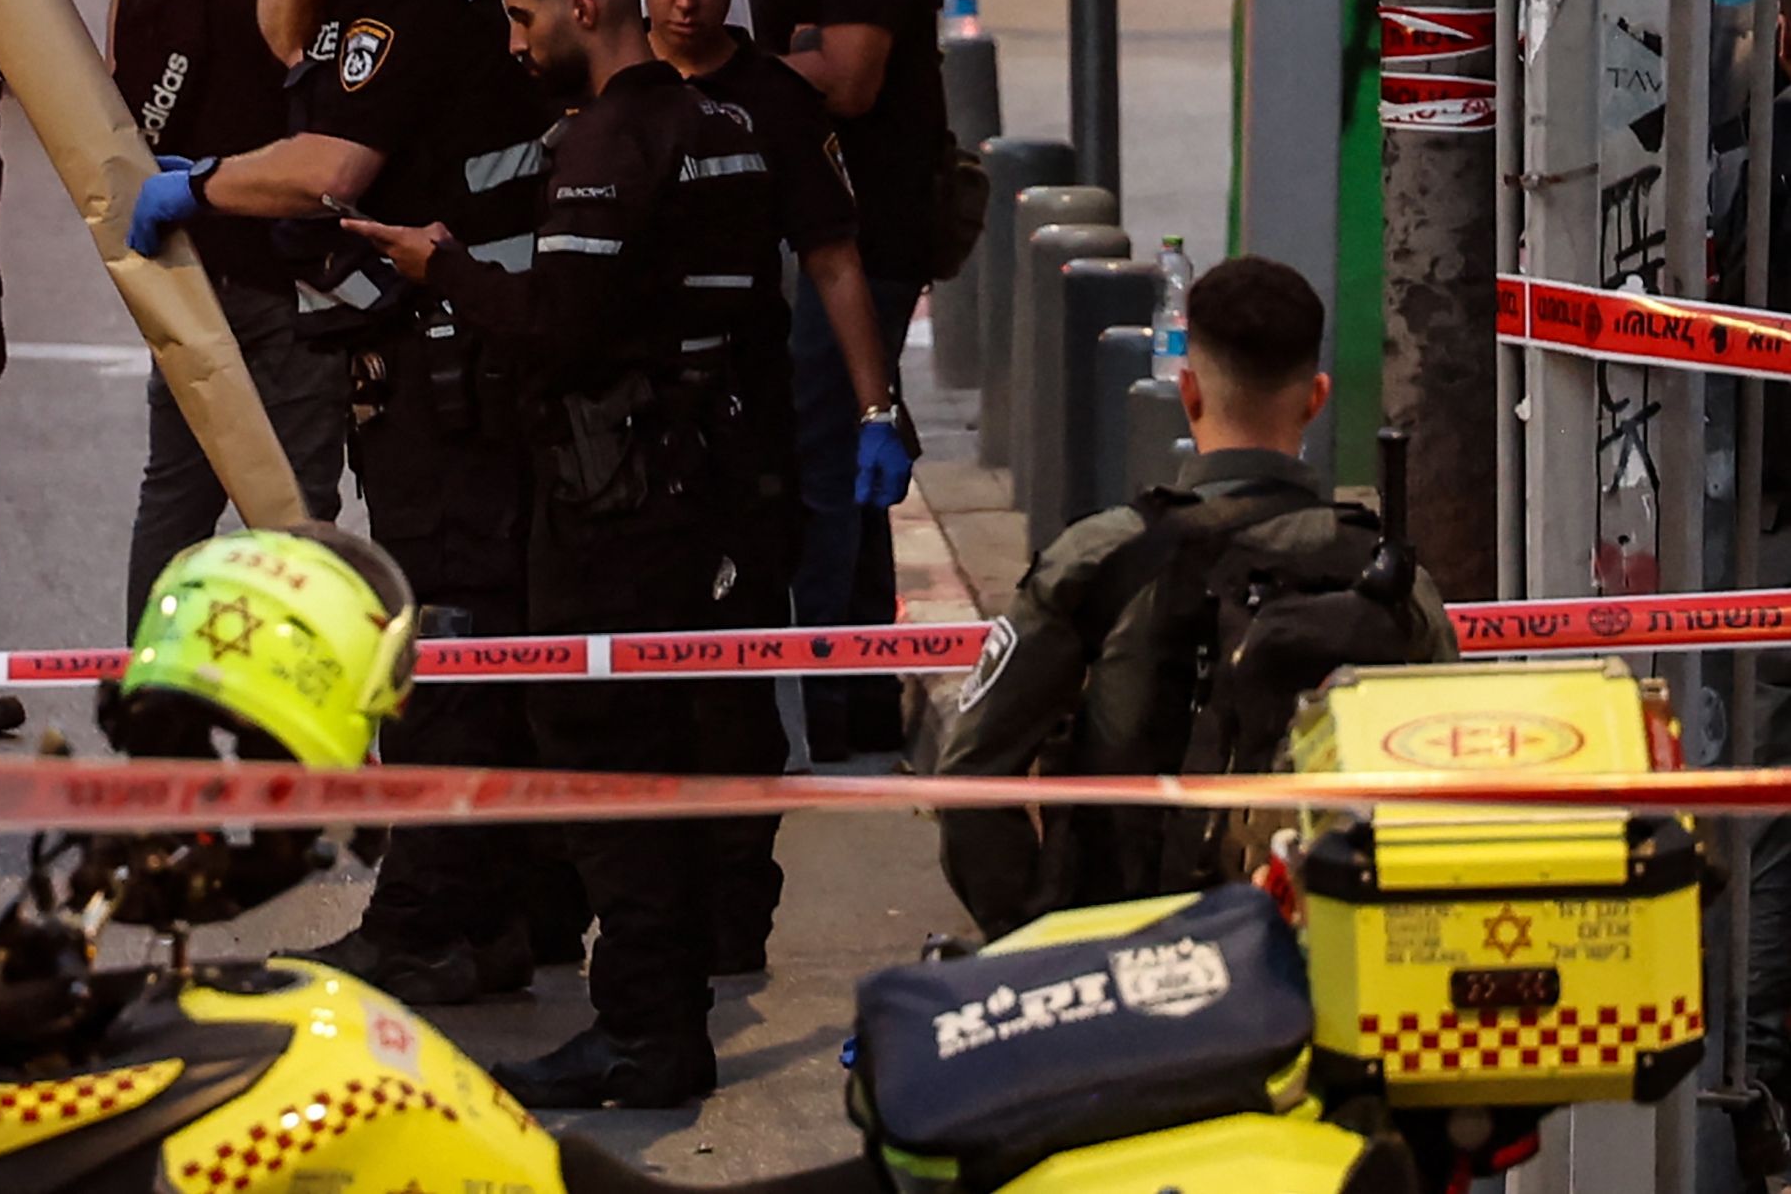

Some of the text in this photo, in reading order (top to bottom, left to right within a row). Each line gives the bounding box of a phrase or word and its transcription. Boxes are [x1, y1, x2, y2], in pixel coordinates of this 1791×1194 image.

[1458, 603, 1783, 639] משטרת ישראל
[437, 644, 573, 667] משטרת
[628, 634, 964, 666] ישראל אין מעבר
